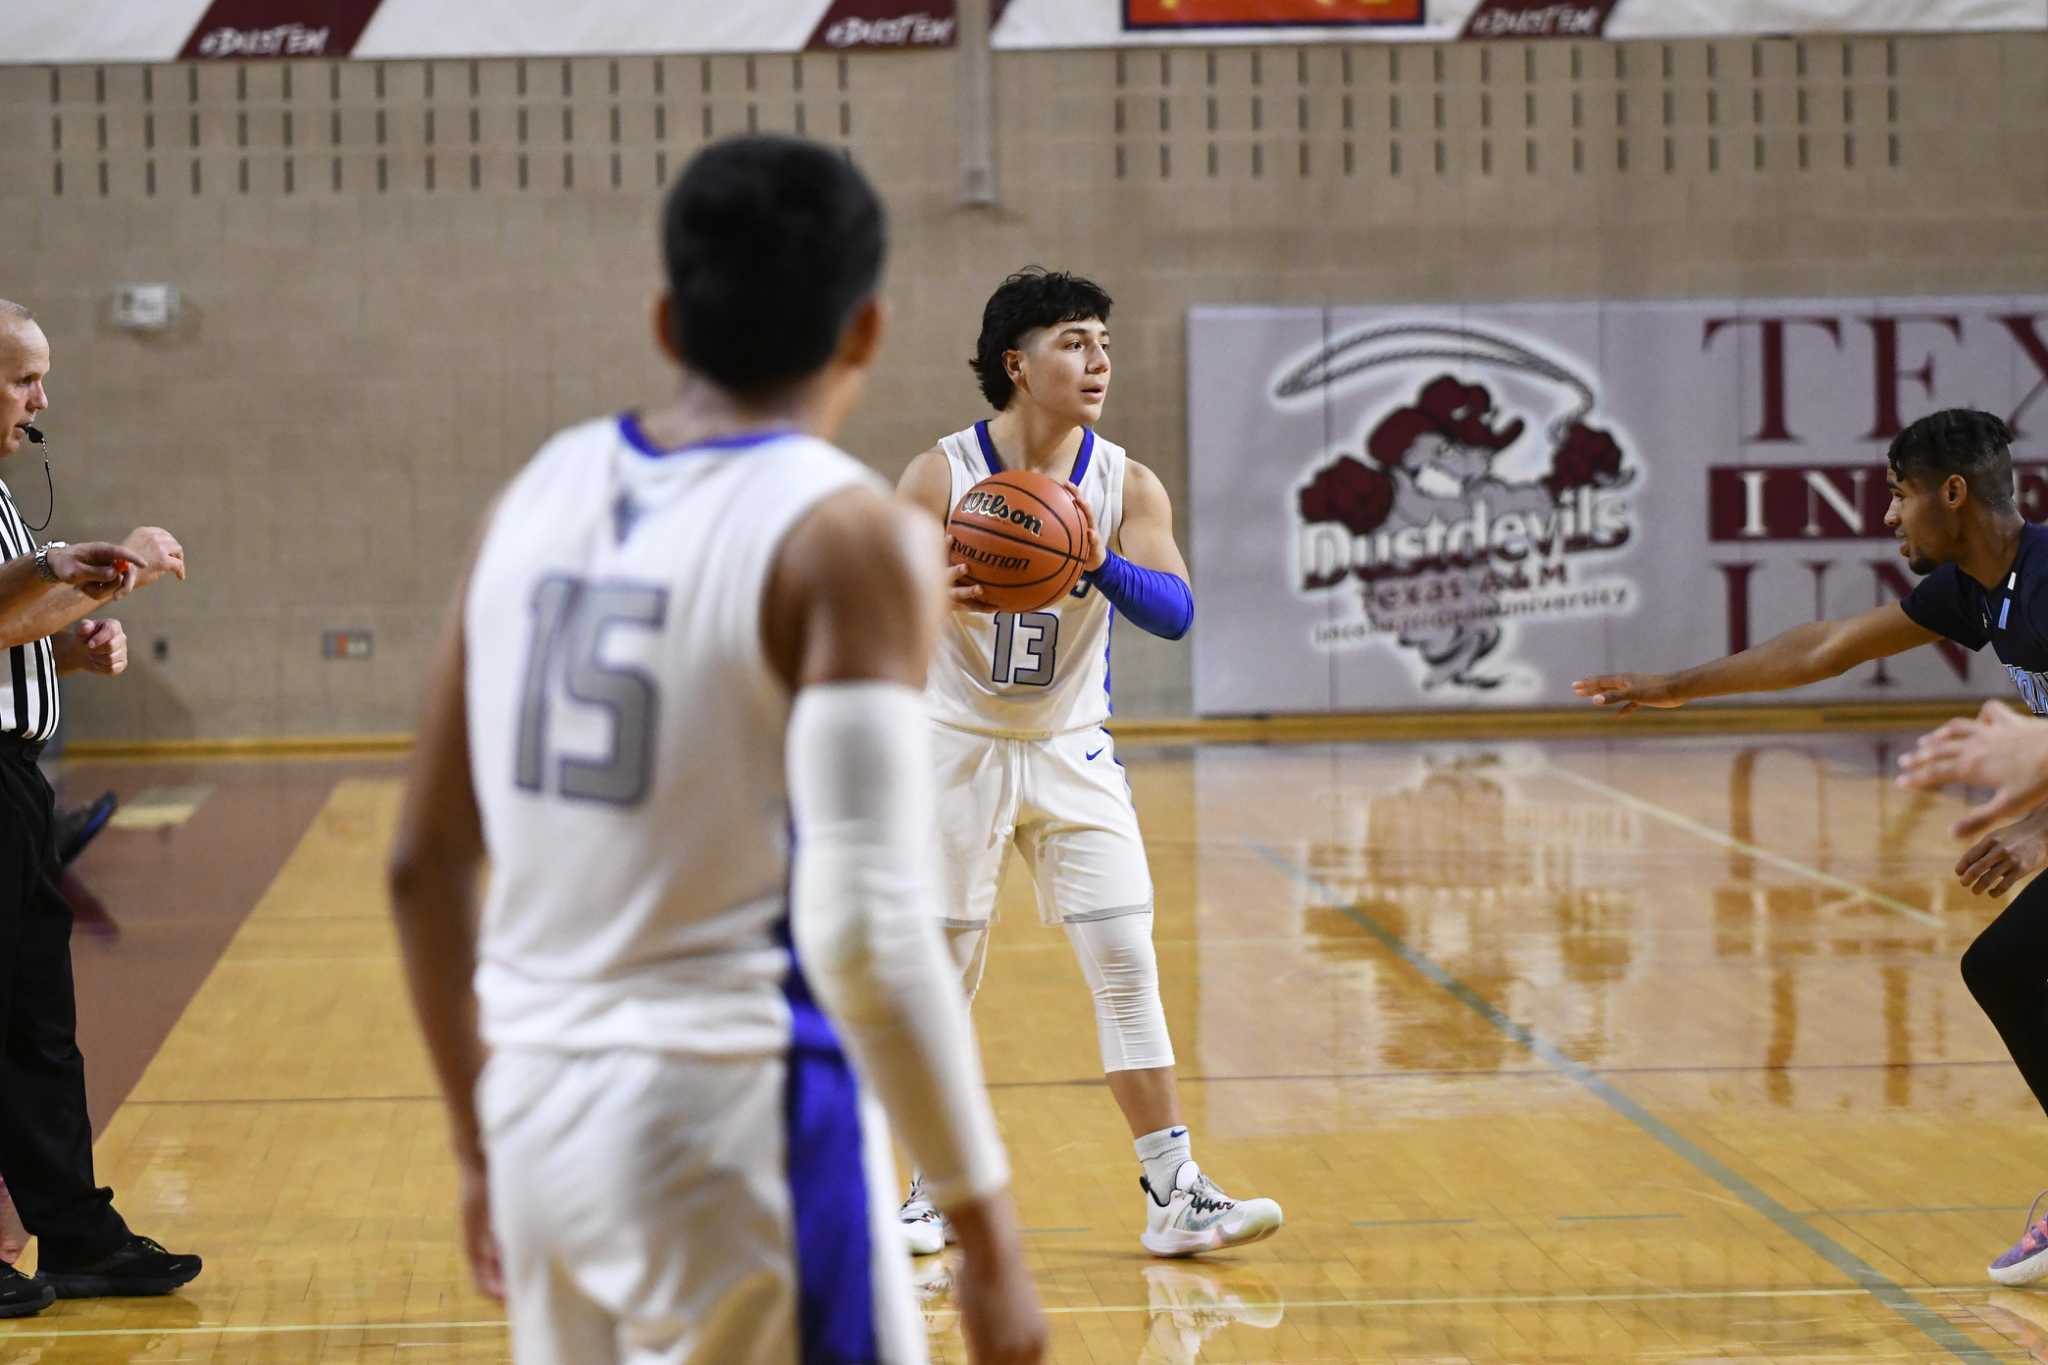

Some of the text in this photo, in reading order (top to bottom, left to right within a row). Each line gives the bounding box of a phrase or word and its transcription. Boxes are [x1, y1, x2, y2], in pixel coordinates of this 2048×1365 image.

[960, 490, 1044, 538] Wilson
[1300, 486, 1632, 592] Dustdevils
[515, 573, 668, 808] 15
[992, 610, 1060, 686] 13
